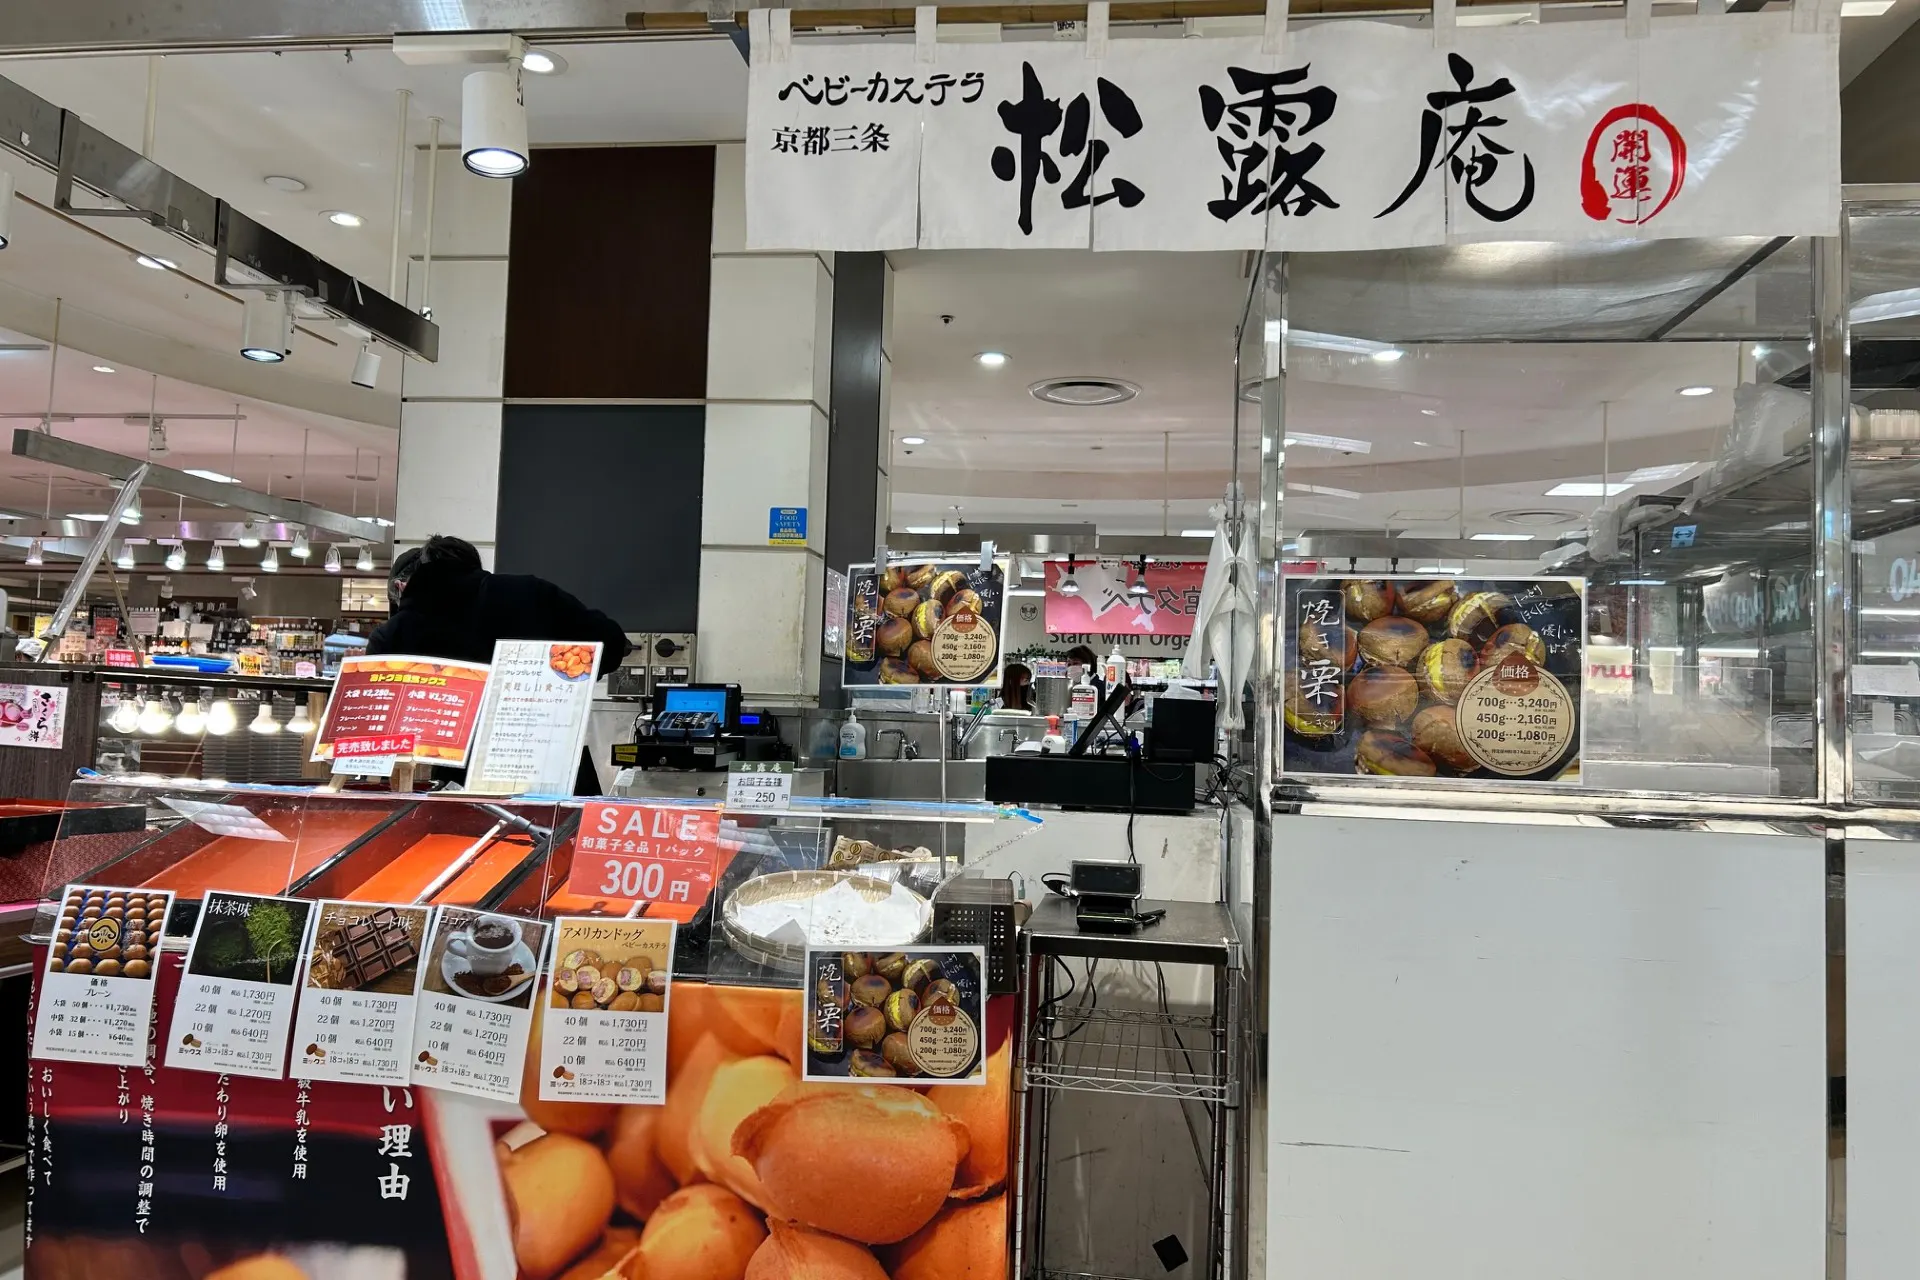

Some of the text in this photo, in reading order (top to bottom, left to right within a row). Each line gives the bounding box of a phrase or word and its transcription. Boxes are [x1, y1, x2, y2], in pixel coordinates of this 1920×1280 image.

[778, 72, 985, 106] ベビーカステラ
[771, 123, 891, 156] 京都三条
[991, 52, 1535, 236] 松露庵
[854, 580, 876, 644] 焼き栗
[1101, 634, 1140, 645] with
[1300, 599, 1341, 705] 焼き栗
[1501, 665, 1530, 679] 価格
[337, 739, 411, 754] 完売致しました
[738, 777, 782, 787] お団子各種
[755, 792, 776, 803] 250
[598, 807, 701, 842] SALE
[581, 836, 649, 854] 和菓子全品
[600, 859, 664, 898] 300
[208, 899, 252, 918] 抹茶味
[324, 912, 414, 931] チョコレート味
[563, 927, 645, 941] アメリカンドッグ
[621, 942, 667, 950] ベビーカステラ
[84, 988, 112, 998] プレーン
[817, 963, 841, 1033] 焼き栗
[53, 999, 66, 1007] 大袋
[933, 1005, 950, 1014] 価格
[51, 1013, 64, 1022] 中袋
[49, 1028, 62, 1036] 小袋
[41, 1066, 53, 1186] おいしく食べて
